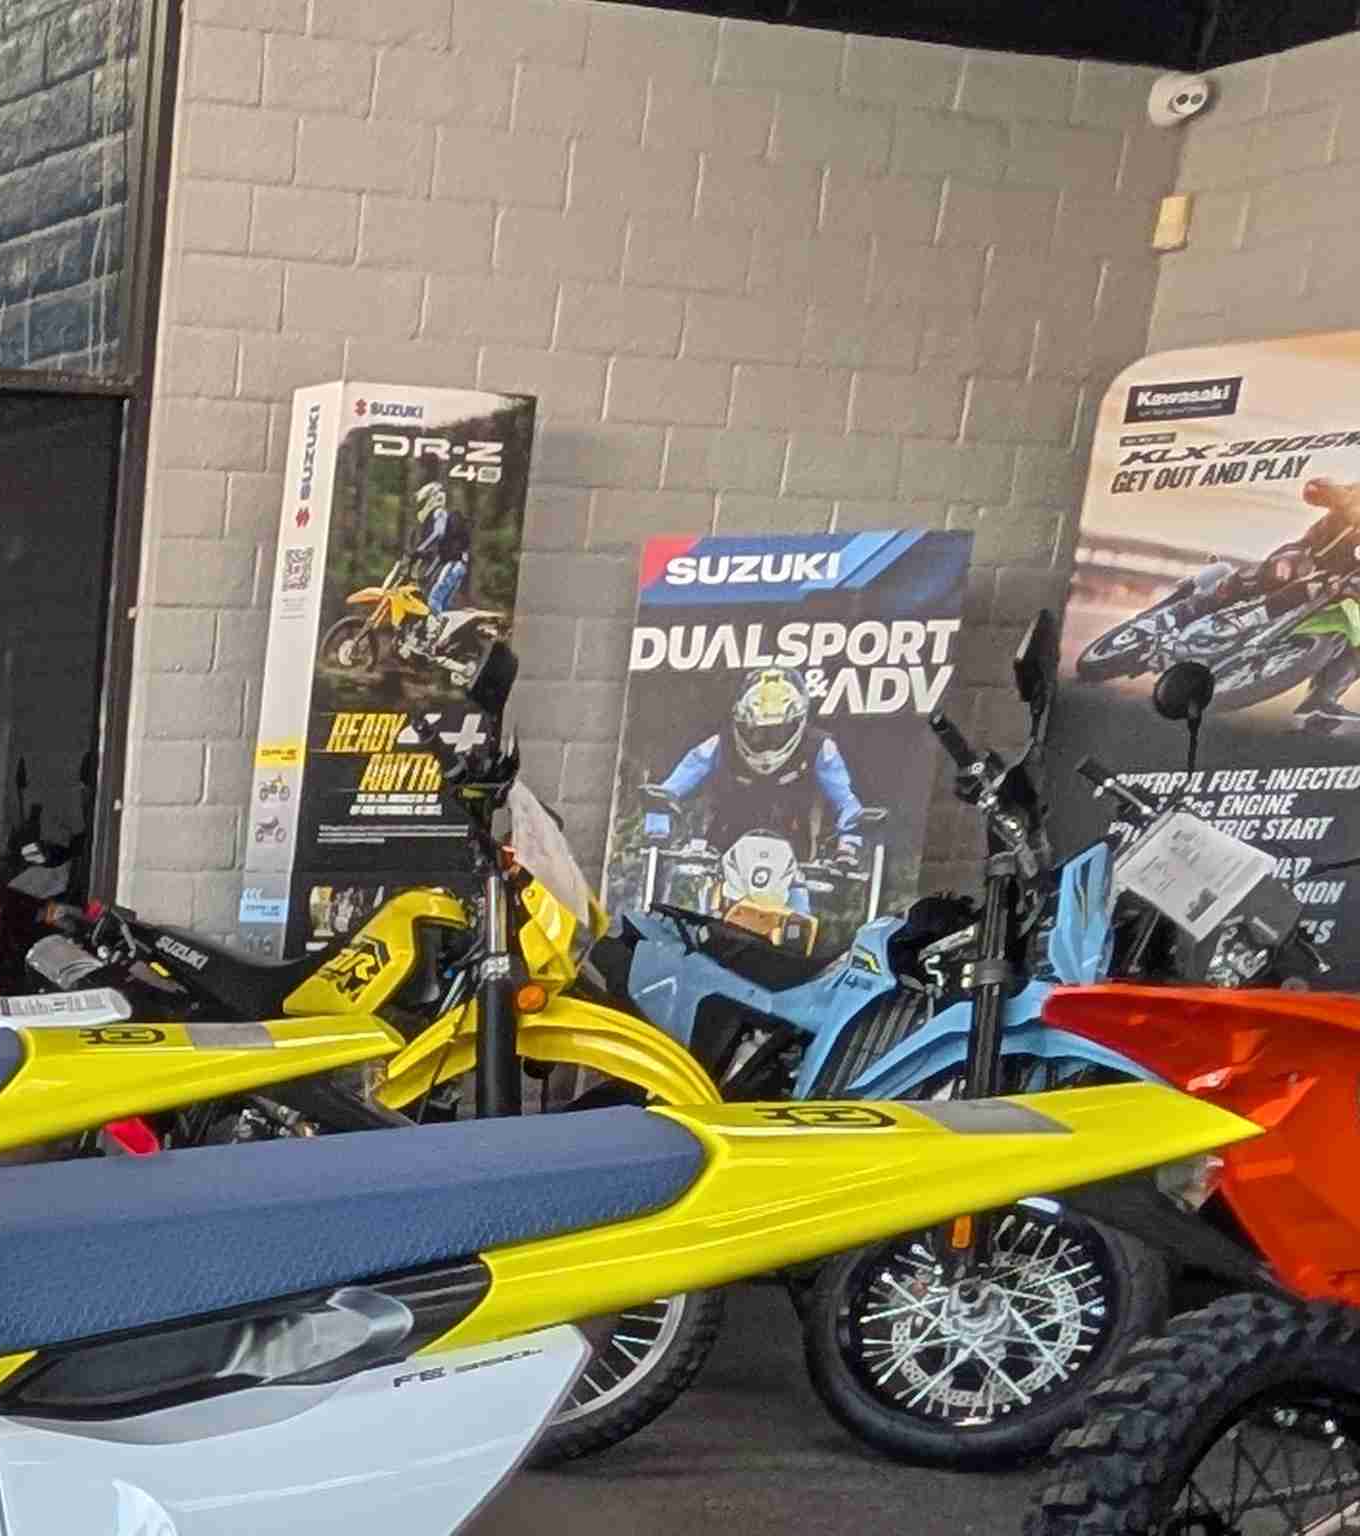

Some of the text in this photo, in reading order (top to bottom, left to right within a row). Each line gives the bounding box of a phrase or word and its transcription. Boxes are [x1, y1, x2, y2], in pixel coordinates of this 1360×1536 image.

[369, 401, 424, 418] SUZUKI
[1136, 384, 1232, 406] Kawasaki
[298, 403, 321, 500] SUZUKI
[371, 433, 504, 463] DR-Z
[1111, 454, 1311, 494] GET OUT AND PLAY
[665, 552, 840, 586] SUZUKI
[326, 713, 408, 753] READY
[358, 752, 443, 792] ANYTH
[1206, 765, 1360, 793] FUEL-INJECTED
[1216, 792, 1299, 817] ENGINE
[1261, 816, 1335, 841] START
[155, 935, 210, 971] SUZUKI
